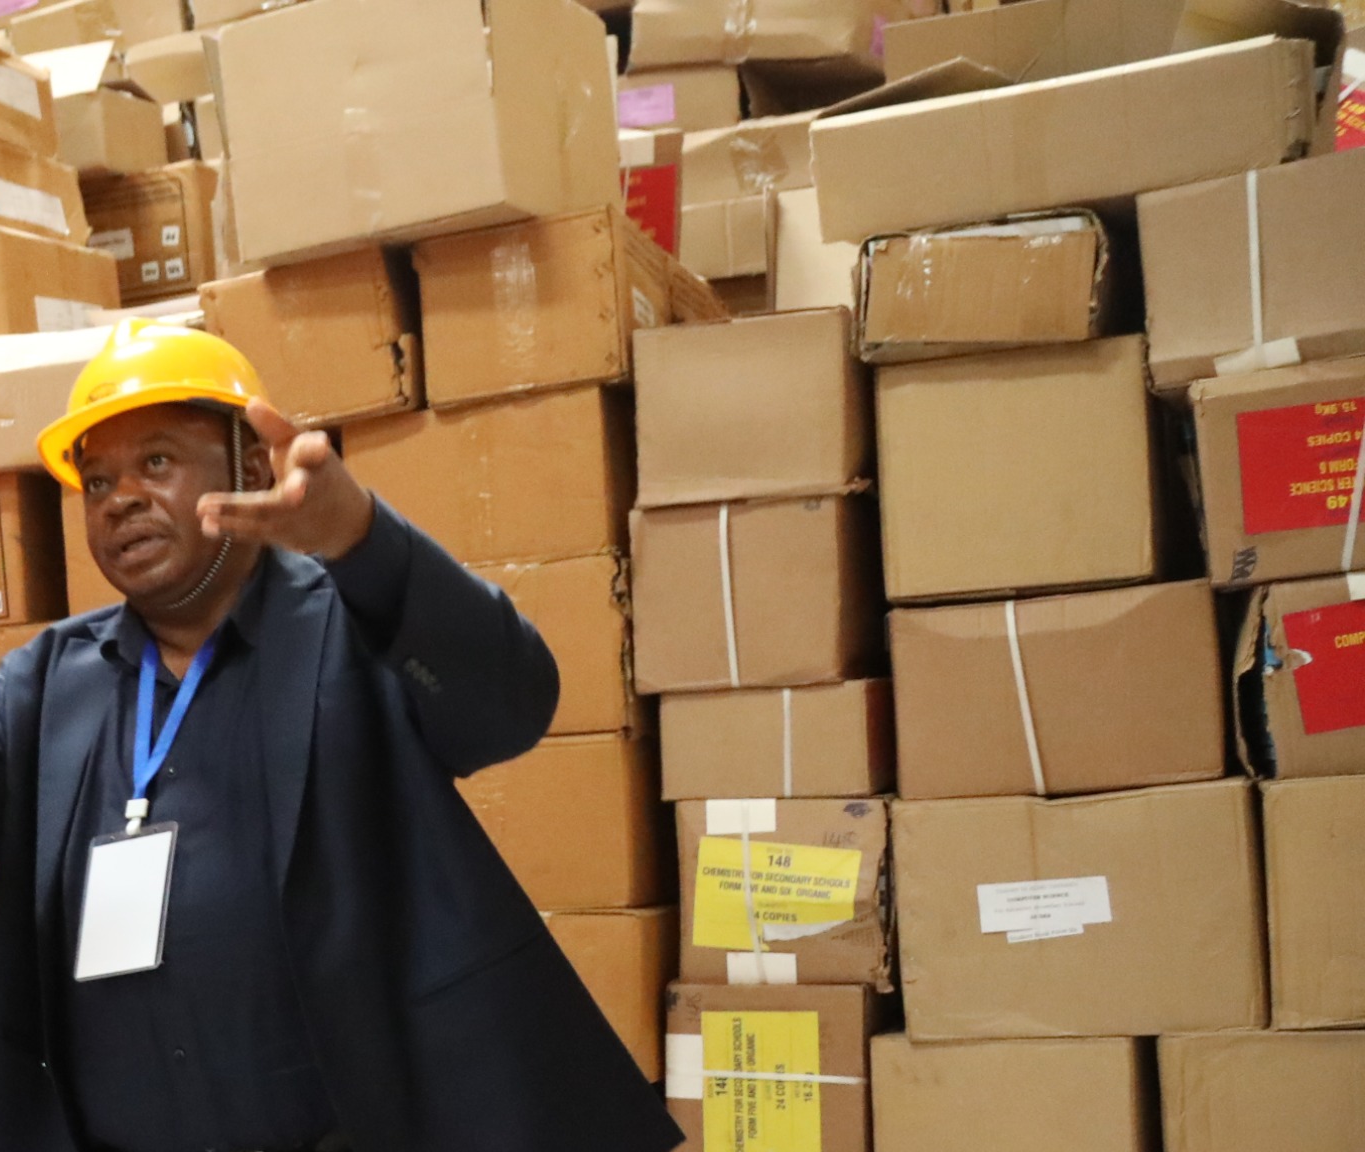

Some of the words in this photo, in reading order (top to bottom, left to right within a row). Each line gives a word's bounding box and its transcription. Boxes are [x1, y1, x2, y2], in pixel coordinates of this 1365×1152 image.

[1307, 430, 1352, 447] COPIES
[1319, 459, 1326, 474] 6
[1290, 480, 1335, 497] SCIENCE
[767, 854, 792, 869] 148
[765, 872, 812, 886] SECONDARY
[813, 875, 851, 889] SCHOOLS
[719, 880, 742, 891] FORM
[761, 883, 778, 895] AND
[796, 887, 831, 900] ORGANIC
[762, 912, 798, 922] COPIES
[732, 1017, 743, 1053] SCHOOLS
[746, 1033, 756, 1066] ORGANIC
[747, 1084, 757, 1099] AND
[735, 1101, 744, 1115] FOR
[747, 1101, 757, 1118] FIVE
[775, 1097, 786, 1110] 24
[747, 1118, 757, 1139] FORM
